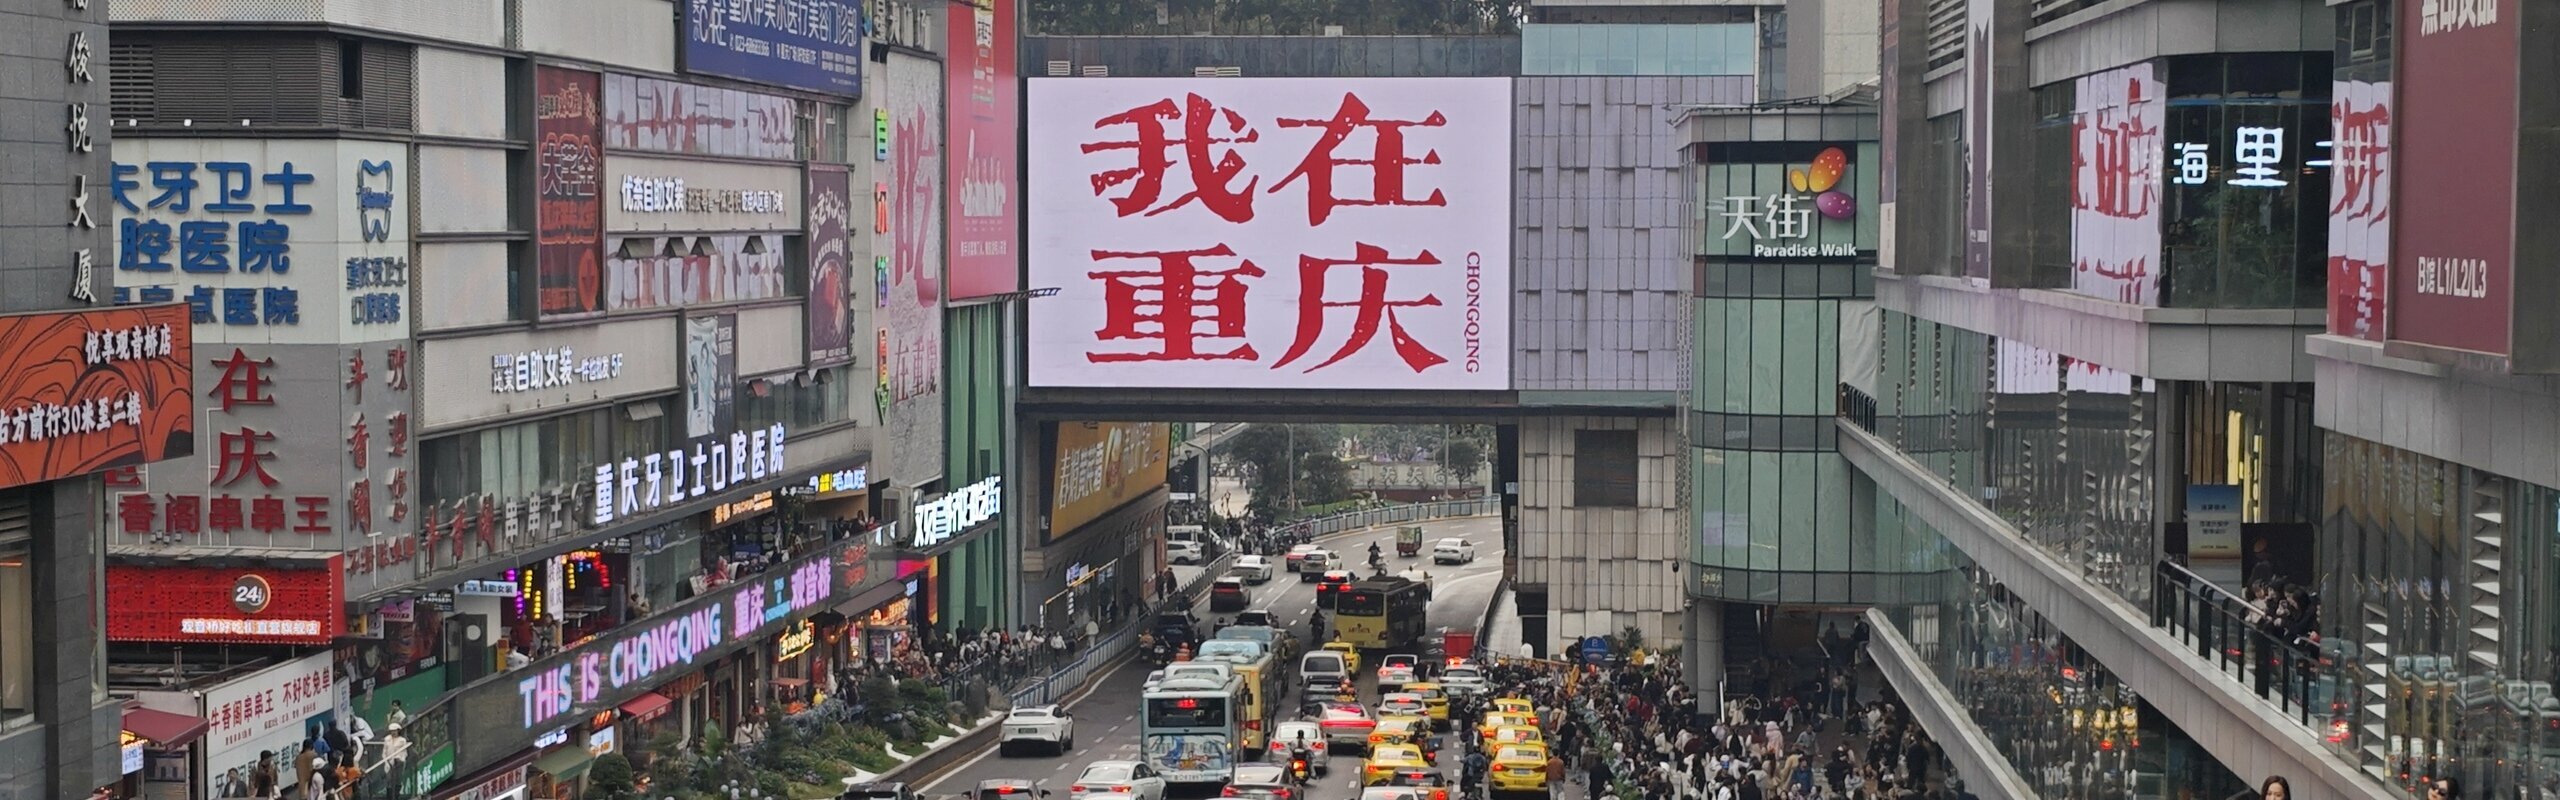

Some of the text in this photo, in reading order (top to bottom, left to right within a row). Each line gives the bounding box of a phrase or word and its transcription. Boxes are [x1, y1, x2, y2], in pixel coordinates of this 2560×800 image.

[69, 0, 97, 303] 俊悦大厦
[1081, 92, 1447, 226] 我在
[119, 218, 291, 274] 腔医院
[1720, 193, 1812, 240] 天街
[1754, 243, 1857, 258] Paradise Walk
[1086, 242, 1449, 375] 重庆
[1465, 251, 1481, 375] CHONGQING
[2418, 257, 2436, 296] B馆
[85, 322, 173, 365] 悦享观音桥店
[515, 346, 573, 391] 自助女装
[611, 353, 623, 378] 5F
[595, 421, 785, 524] 重庆牙卫士口腔医院
[734, 583, 766, 639] 重庆
[790, 555, 832, 611] 观音桥
[210, 688, 274, 735] 牛香阁串串王
[282, 665, 331, 708] 不好吃免单
[519, 663, 573, 729] THIS
[581, 652, 600, 704] IS
[609, 602, 722, 689] CHONGQING
